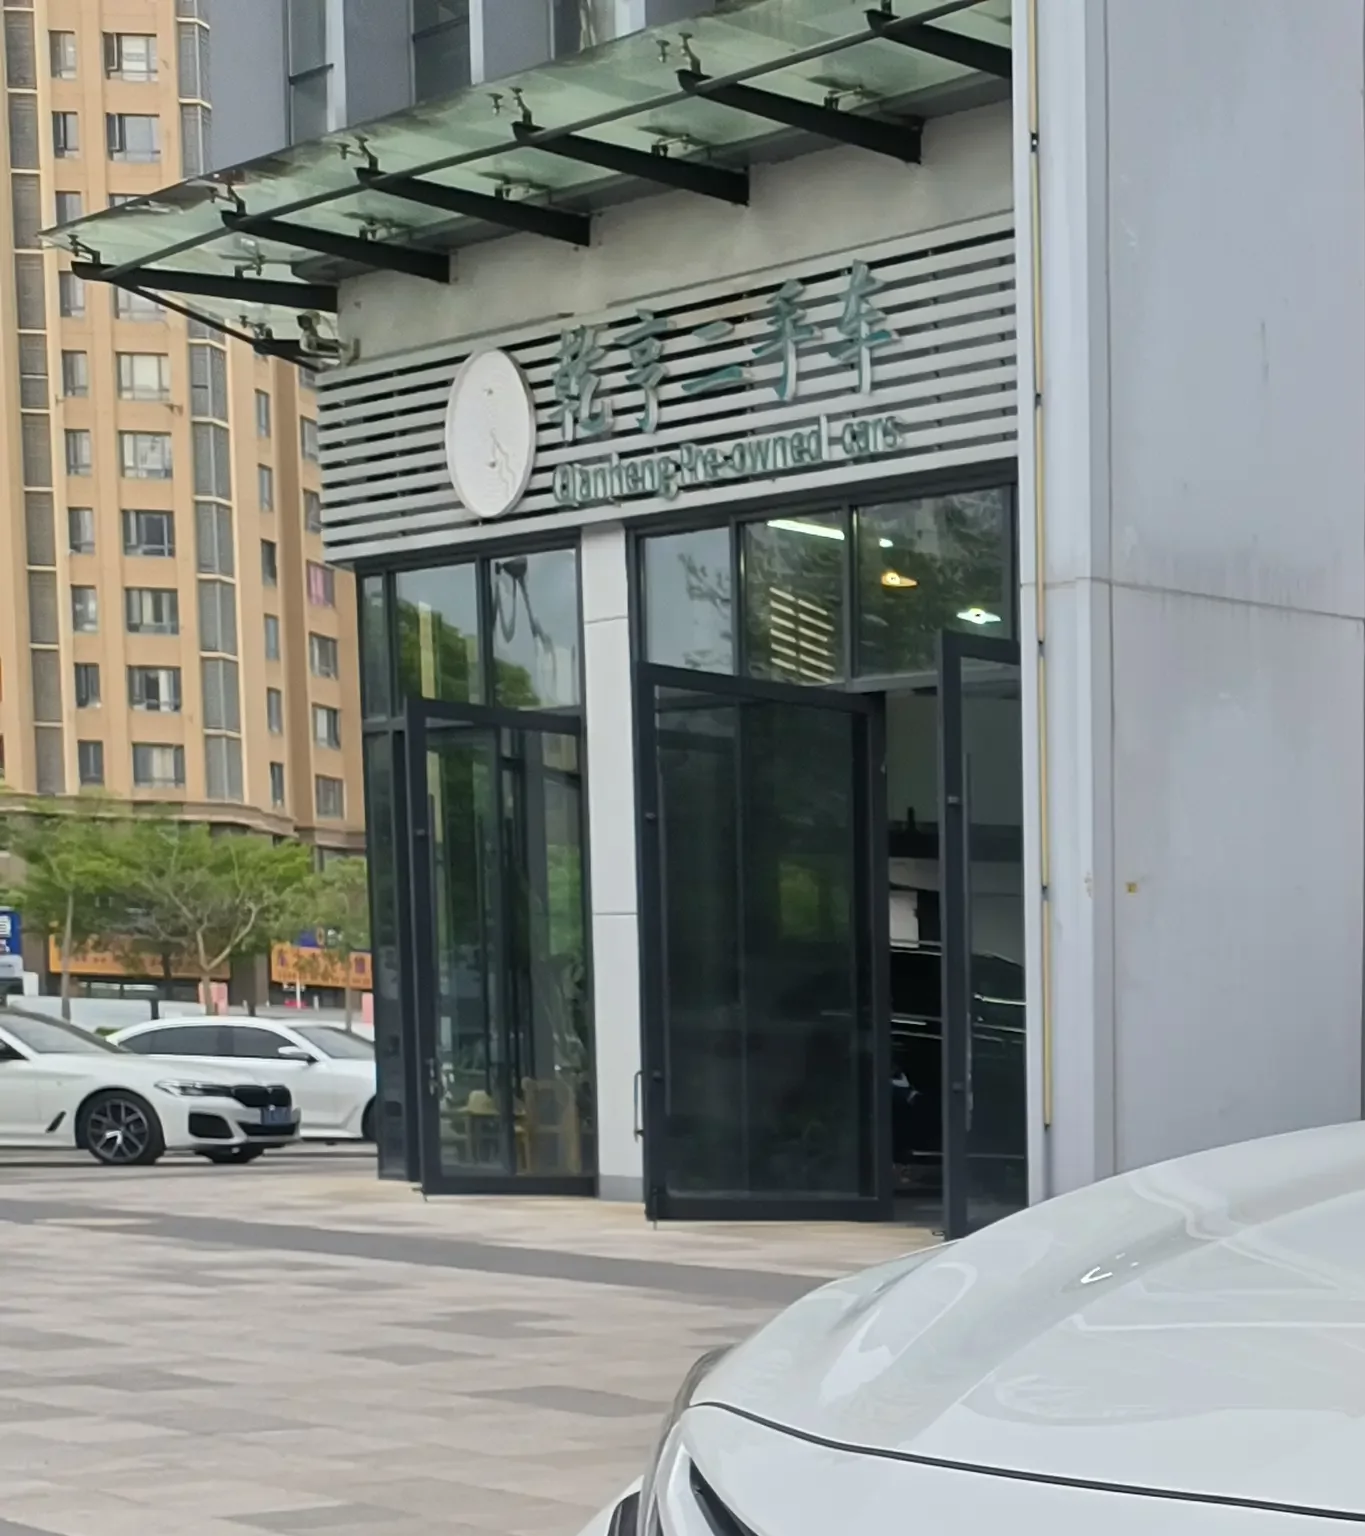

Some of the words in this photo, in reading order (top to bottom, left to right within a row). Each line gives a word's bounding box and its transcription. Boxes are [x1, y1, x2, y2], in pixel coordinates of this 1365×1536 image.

[552, 451, 680, 505] Qianheng
[679, 413, 829, 484] Pre-owned
[841, 416, 902, 456] cars
